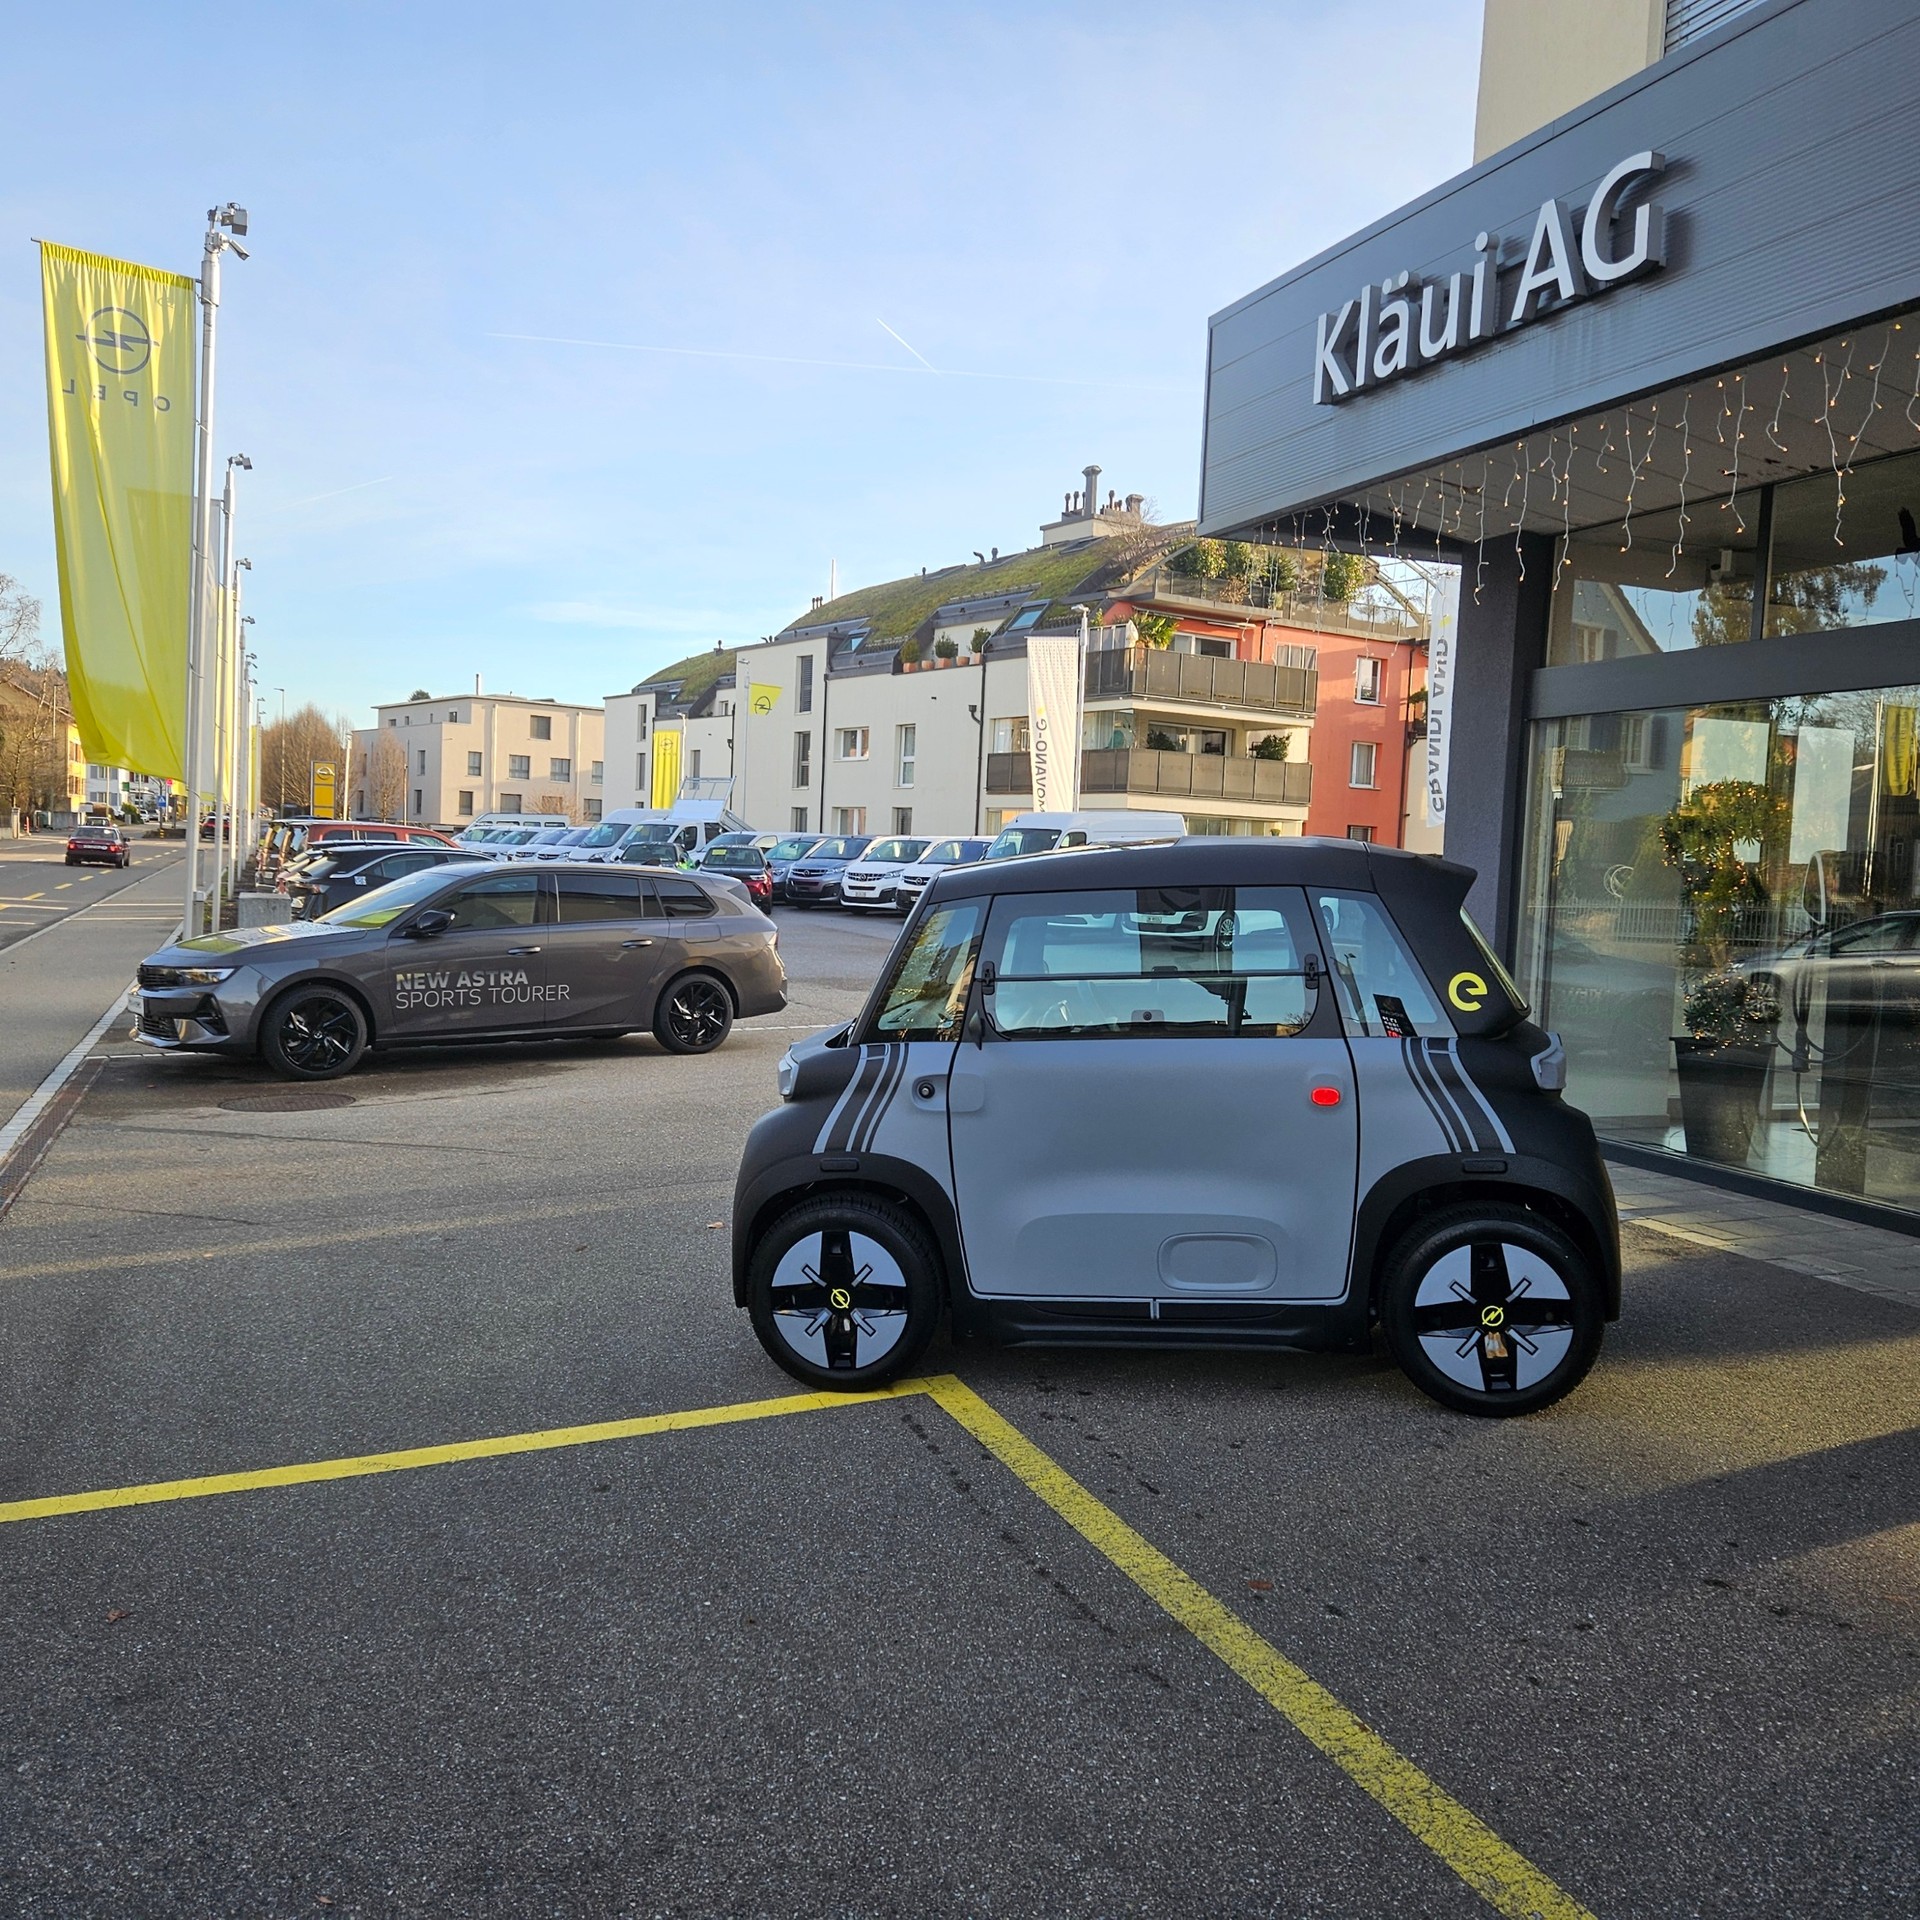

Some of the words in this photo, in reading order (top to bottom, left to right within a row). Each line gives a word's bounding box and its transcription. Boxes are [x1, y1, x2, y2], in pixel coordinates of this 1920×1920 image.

[1313, 231, 1497, 405] Kläui
[1511, 150, 1665, 322] AG
[395, 970, 450, 991] NEW
[456, 968, 529, 988] ASTRA
[395, 988, 482, 1009] SPORTS
[488, 984, 570, 1004] TOURER
